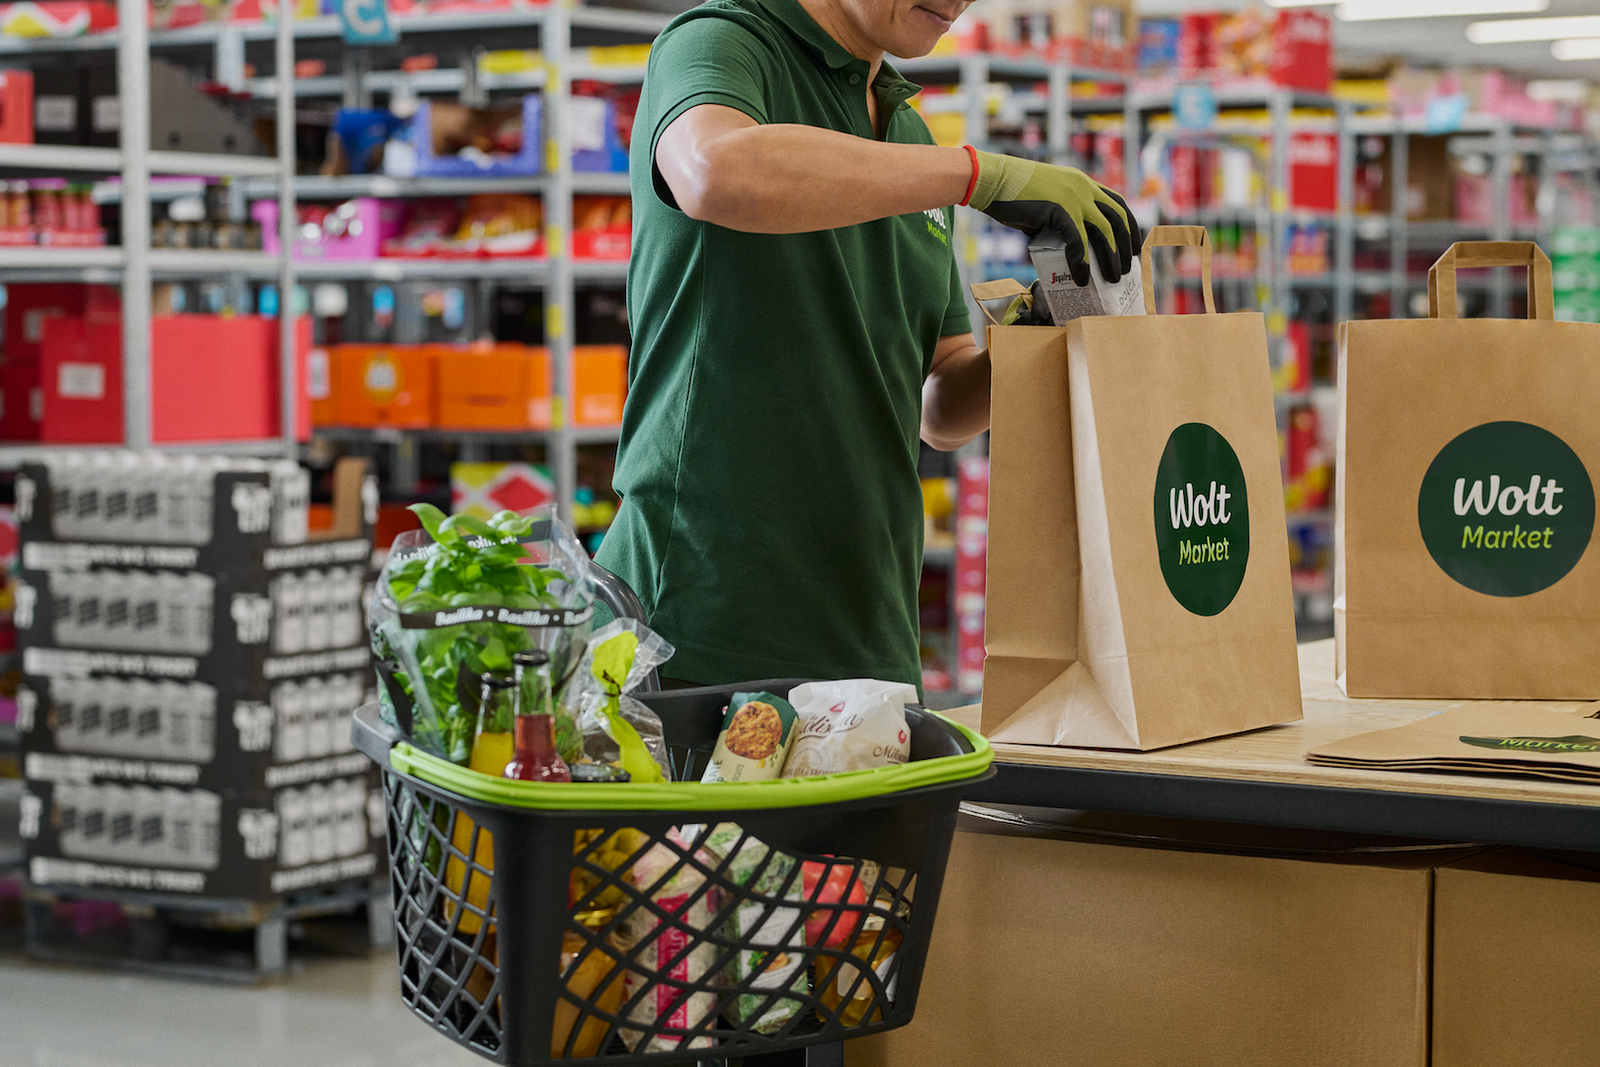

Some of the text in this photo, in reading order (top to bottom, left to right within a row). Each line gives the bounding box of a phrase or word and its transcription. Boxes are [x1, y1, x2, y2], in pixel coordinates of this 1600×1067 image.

[1118, 276, 1137, 306] DOLCE
[1169, 480, 1232, 529] Wolt
[1452, 474, 1564, 516] Wolt
[1179, 535, 1230, 565] Market
[1461, 524, 1554, 549] Market
